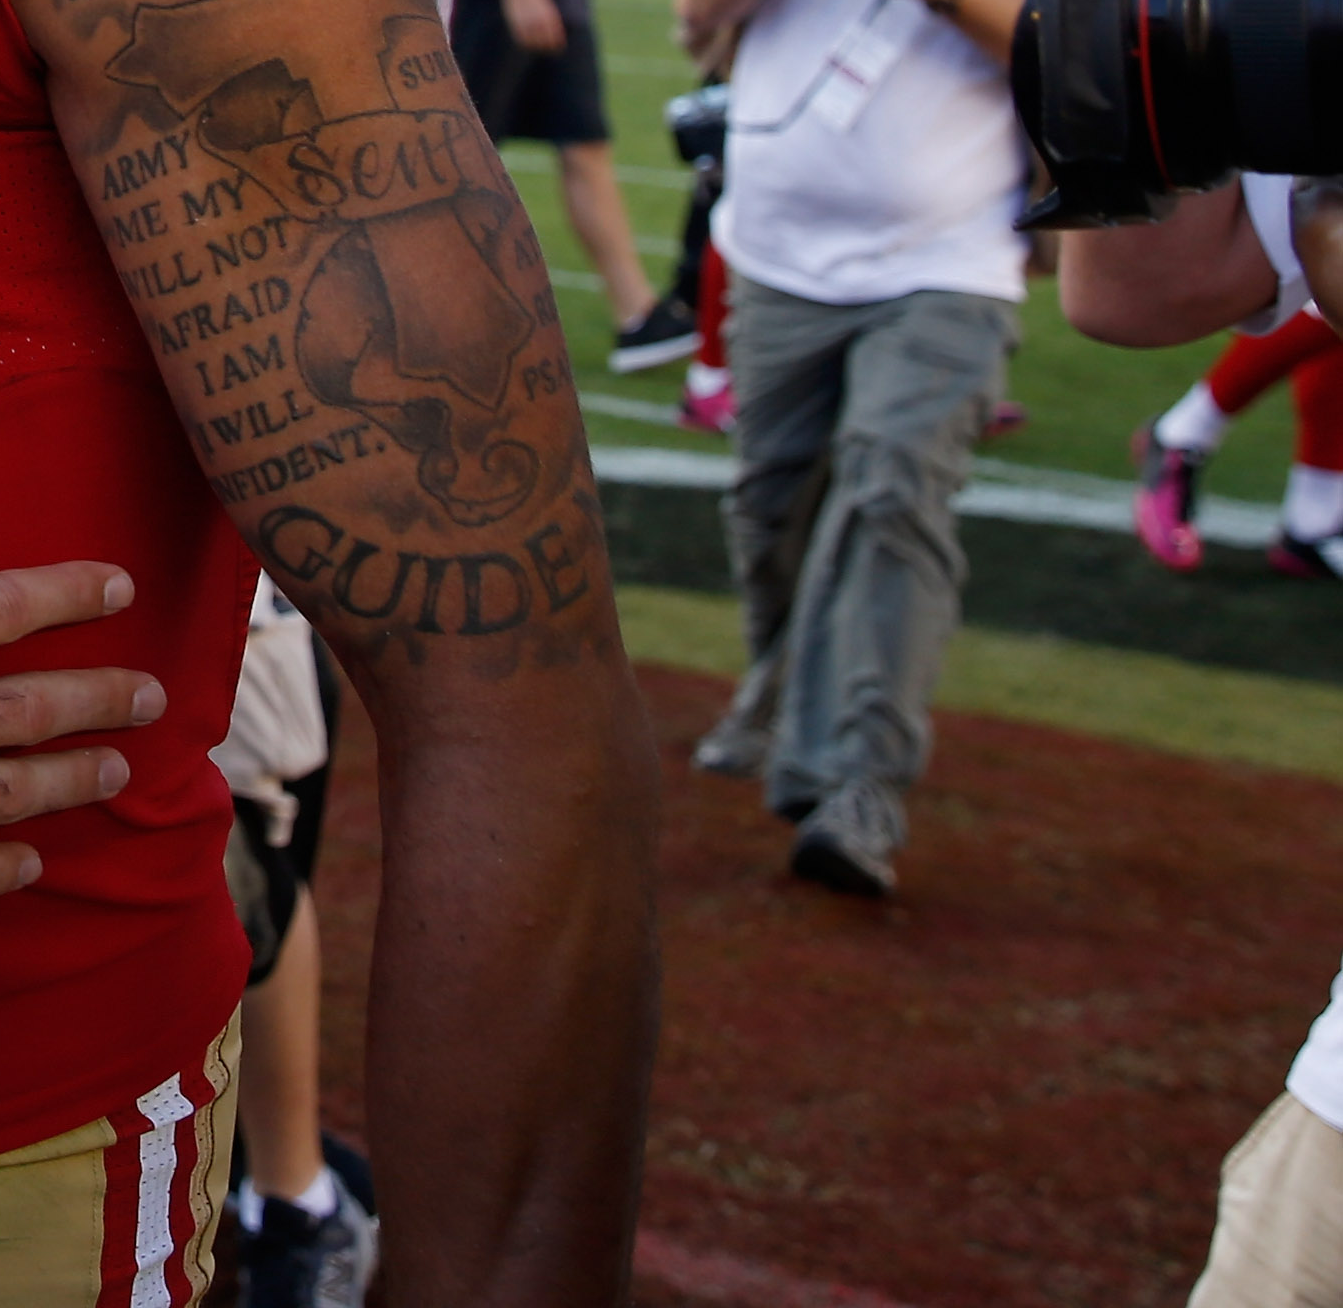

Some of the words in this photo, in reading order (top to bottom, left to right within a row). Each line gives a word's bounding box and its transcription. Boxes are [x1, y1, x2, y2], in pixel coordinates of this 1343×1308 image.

[102, 130, 190, 201] ARMY
[113, 199, 169, 249] ME
[179, 170, 251, 226] MY
[119, 252, 203, 301] WILL
[206, 213, 293, 276] NOT
[155, 276, 292, 355] AFRAID
[195, 360, 214, 397] I
[222, 333, 286, 390] AM
[210, 389, 314, 445] WILL
[257, 505, 589, 635] GUIDE
